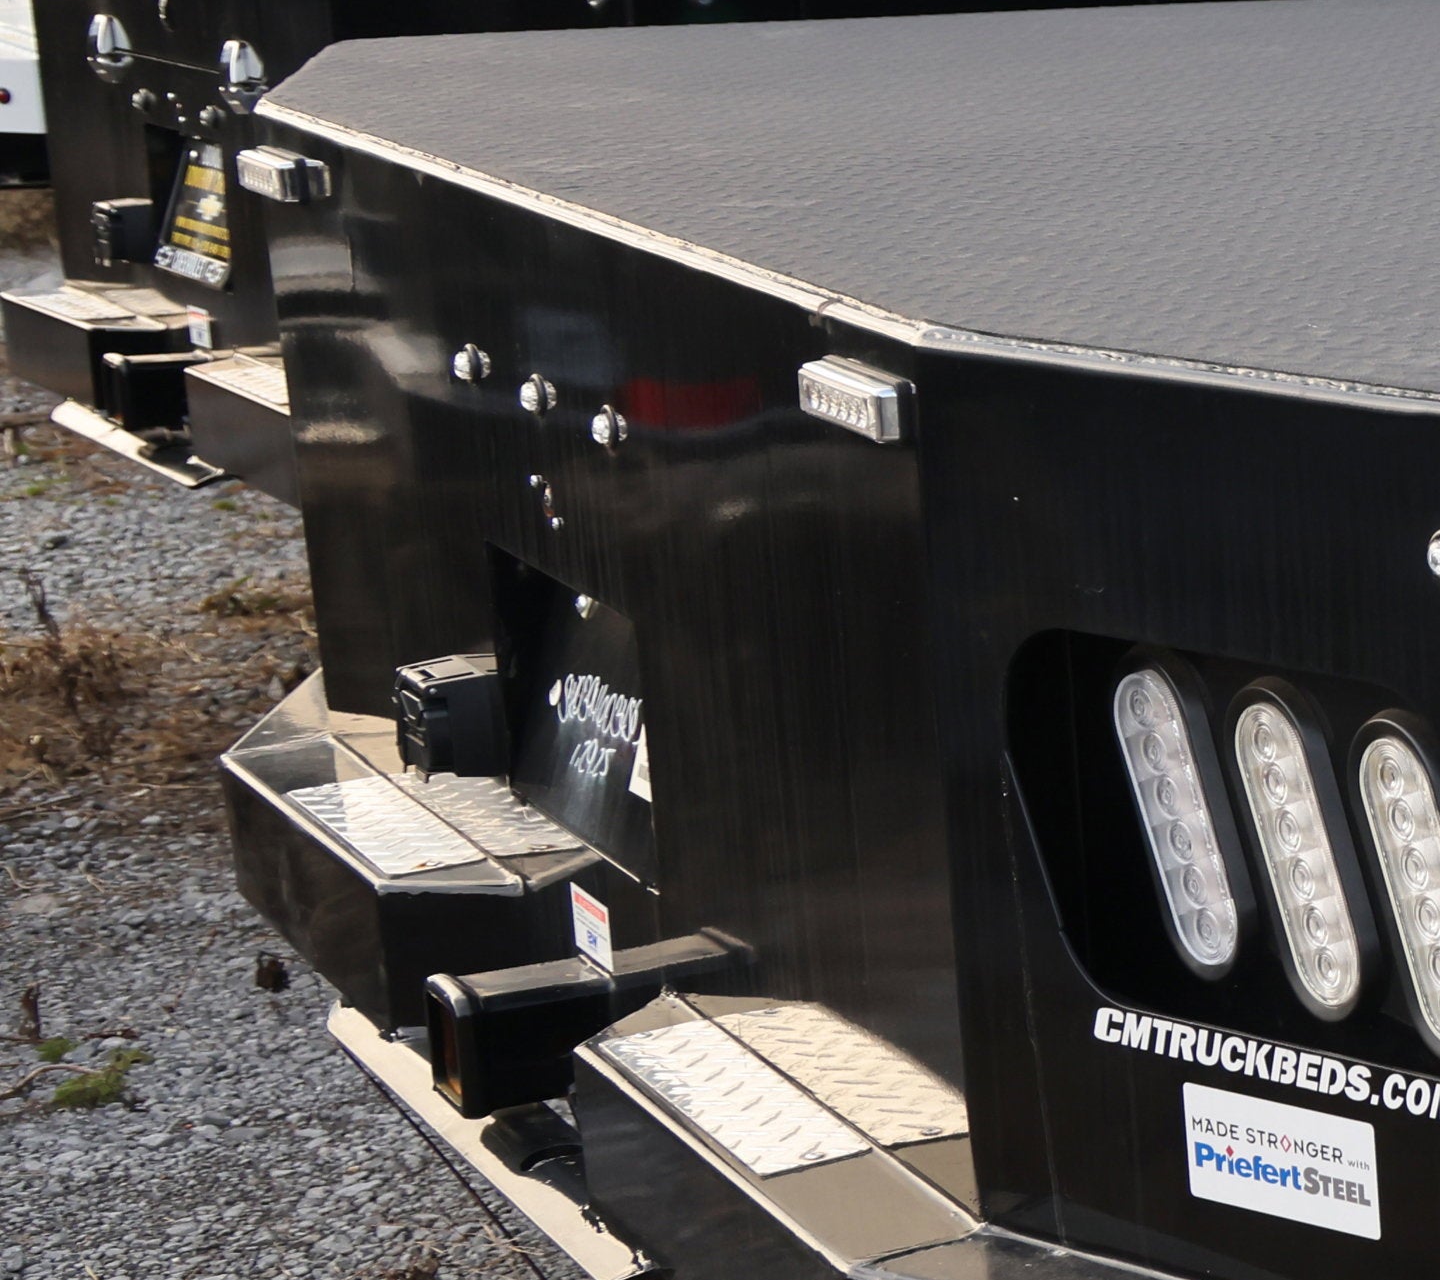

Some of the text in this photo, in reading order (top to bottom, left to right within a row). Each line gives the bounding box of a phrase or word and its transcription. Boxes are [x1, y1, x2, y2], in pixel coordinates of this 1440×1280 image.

[1191, 1115, 1370, 1172] MADE STRONGER with
